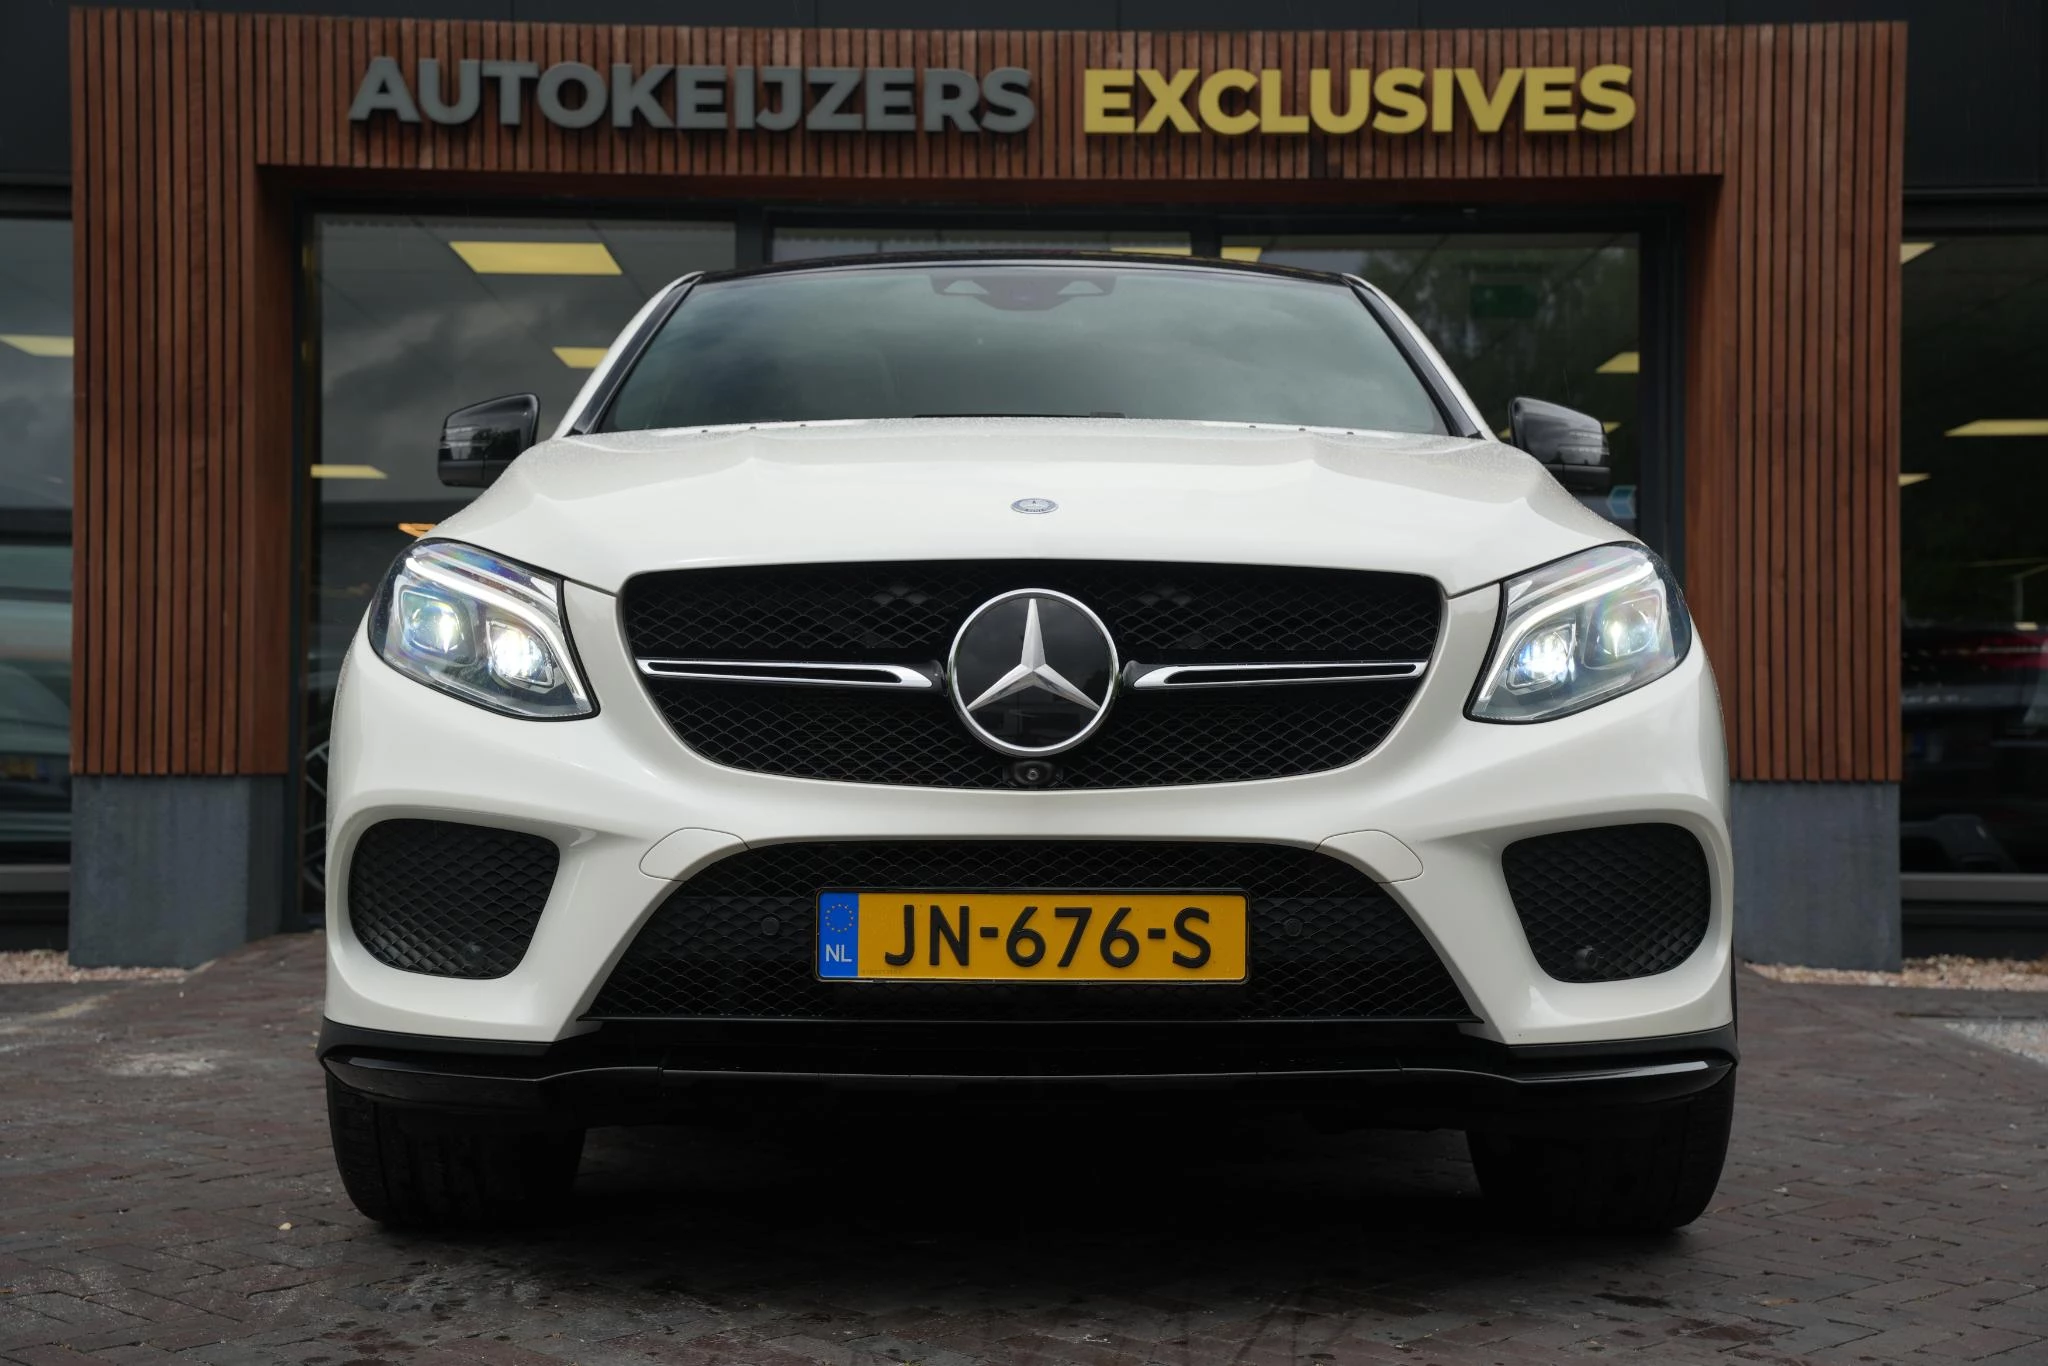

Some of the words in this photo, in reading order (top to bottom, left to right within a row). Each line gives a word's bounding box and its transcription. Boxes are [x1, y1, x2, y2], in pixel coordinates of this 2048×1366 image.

[348, 56, 1037, 134] AUTOKEIJZERS
[1084, 64, 1637, 135] EXCLUSIVES
[825, 944, 852, 962] NL
[885, 904, 1211, 969] JN-676-S
